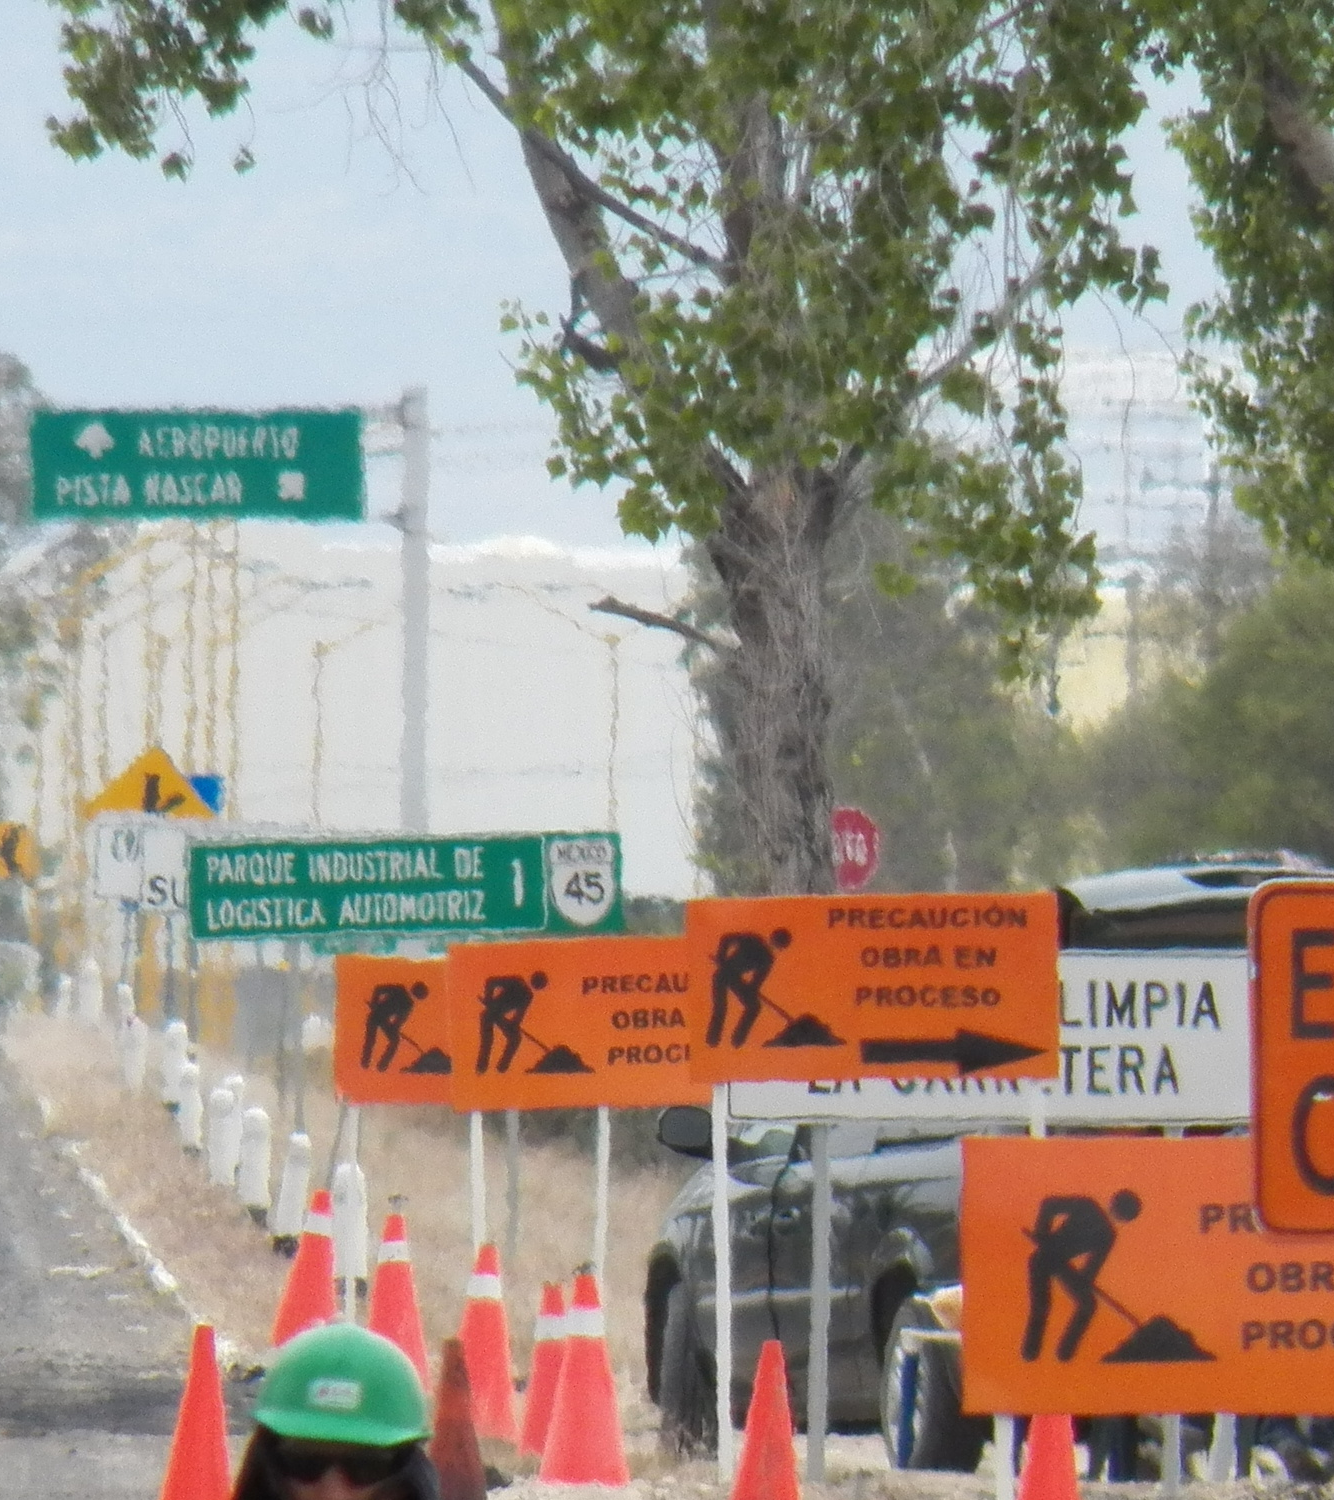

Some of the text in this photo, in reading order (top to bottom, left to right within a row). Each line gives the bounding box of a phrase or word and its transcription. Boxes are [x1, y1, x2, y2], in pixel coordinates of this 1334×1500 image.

[138, 427, 300, 459] AEROPUERTO
[56, 471, 243, 506] PISTA NASCAR
[205, 845, 485, 886] PARQUE INDUSTRIAL DE
[511, 858, 524, 907] 1
[564, 871, 606, 905] 45
[206, 889, 487, 932] LOGISTICA AUTOMOTRIZ
[827, 904, 1028, 930] PRECAUCIÓN
[860, 945, 998, 969] OBRA EN
[582, 973, 689, 995] PRECAU
[854, 985, 1002, 1008] PROCESO
[612, 1007, 686, 1030] OBRA
[1058, 979, 1222, 1029] LIMPIA
